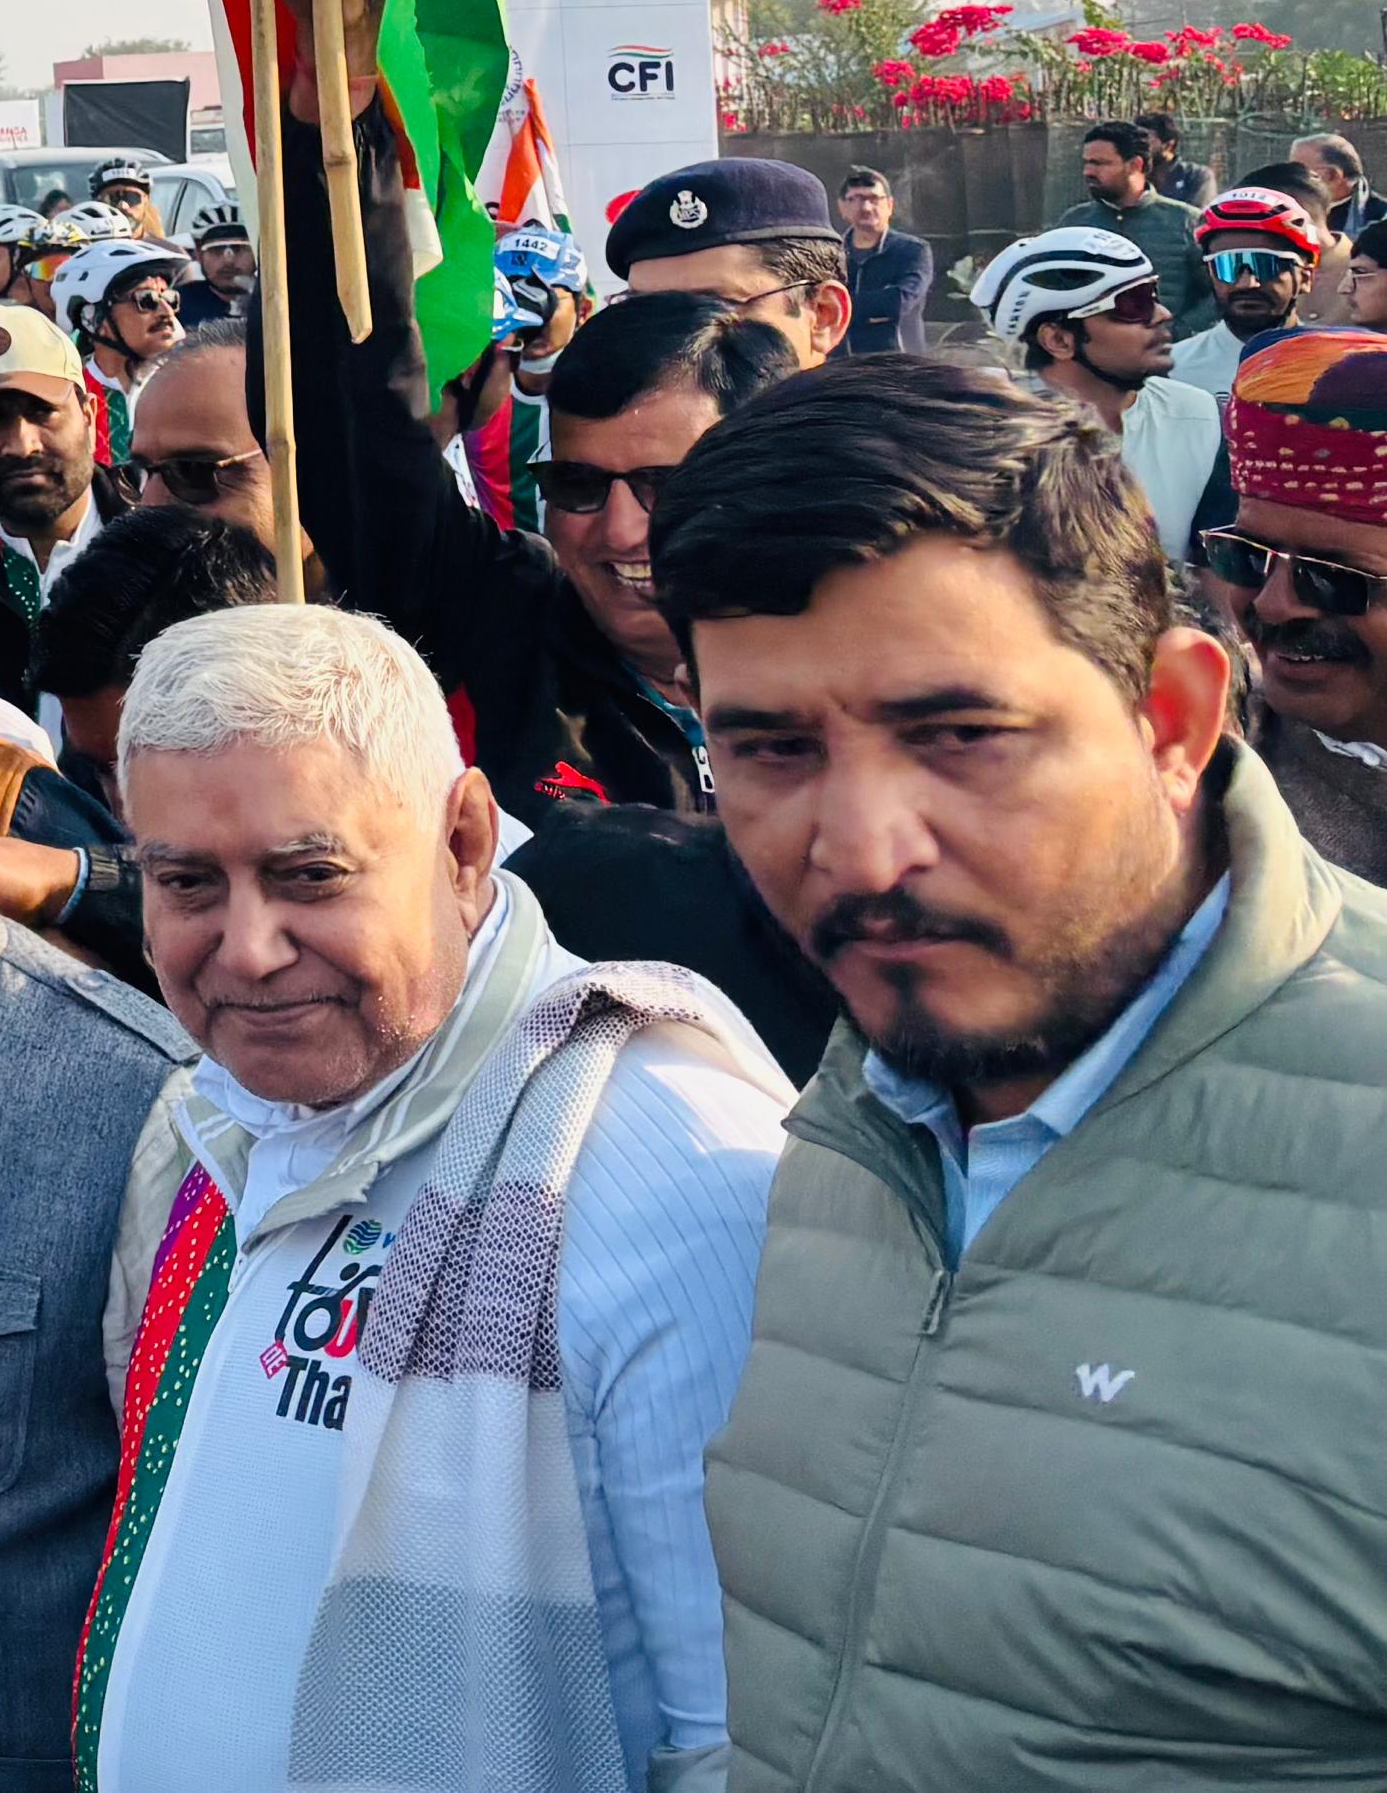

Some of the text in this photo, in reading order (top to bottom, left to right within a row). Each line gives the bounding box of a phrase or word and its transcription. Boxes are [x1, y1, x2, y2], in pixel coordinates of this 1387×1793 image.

[608, 60, 674, 93] CFI
[514, 238, 548, 251] 1442
[276, 1355, 352, 1431] Tha
